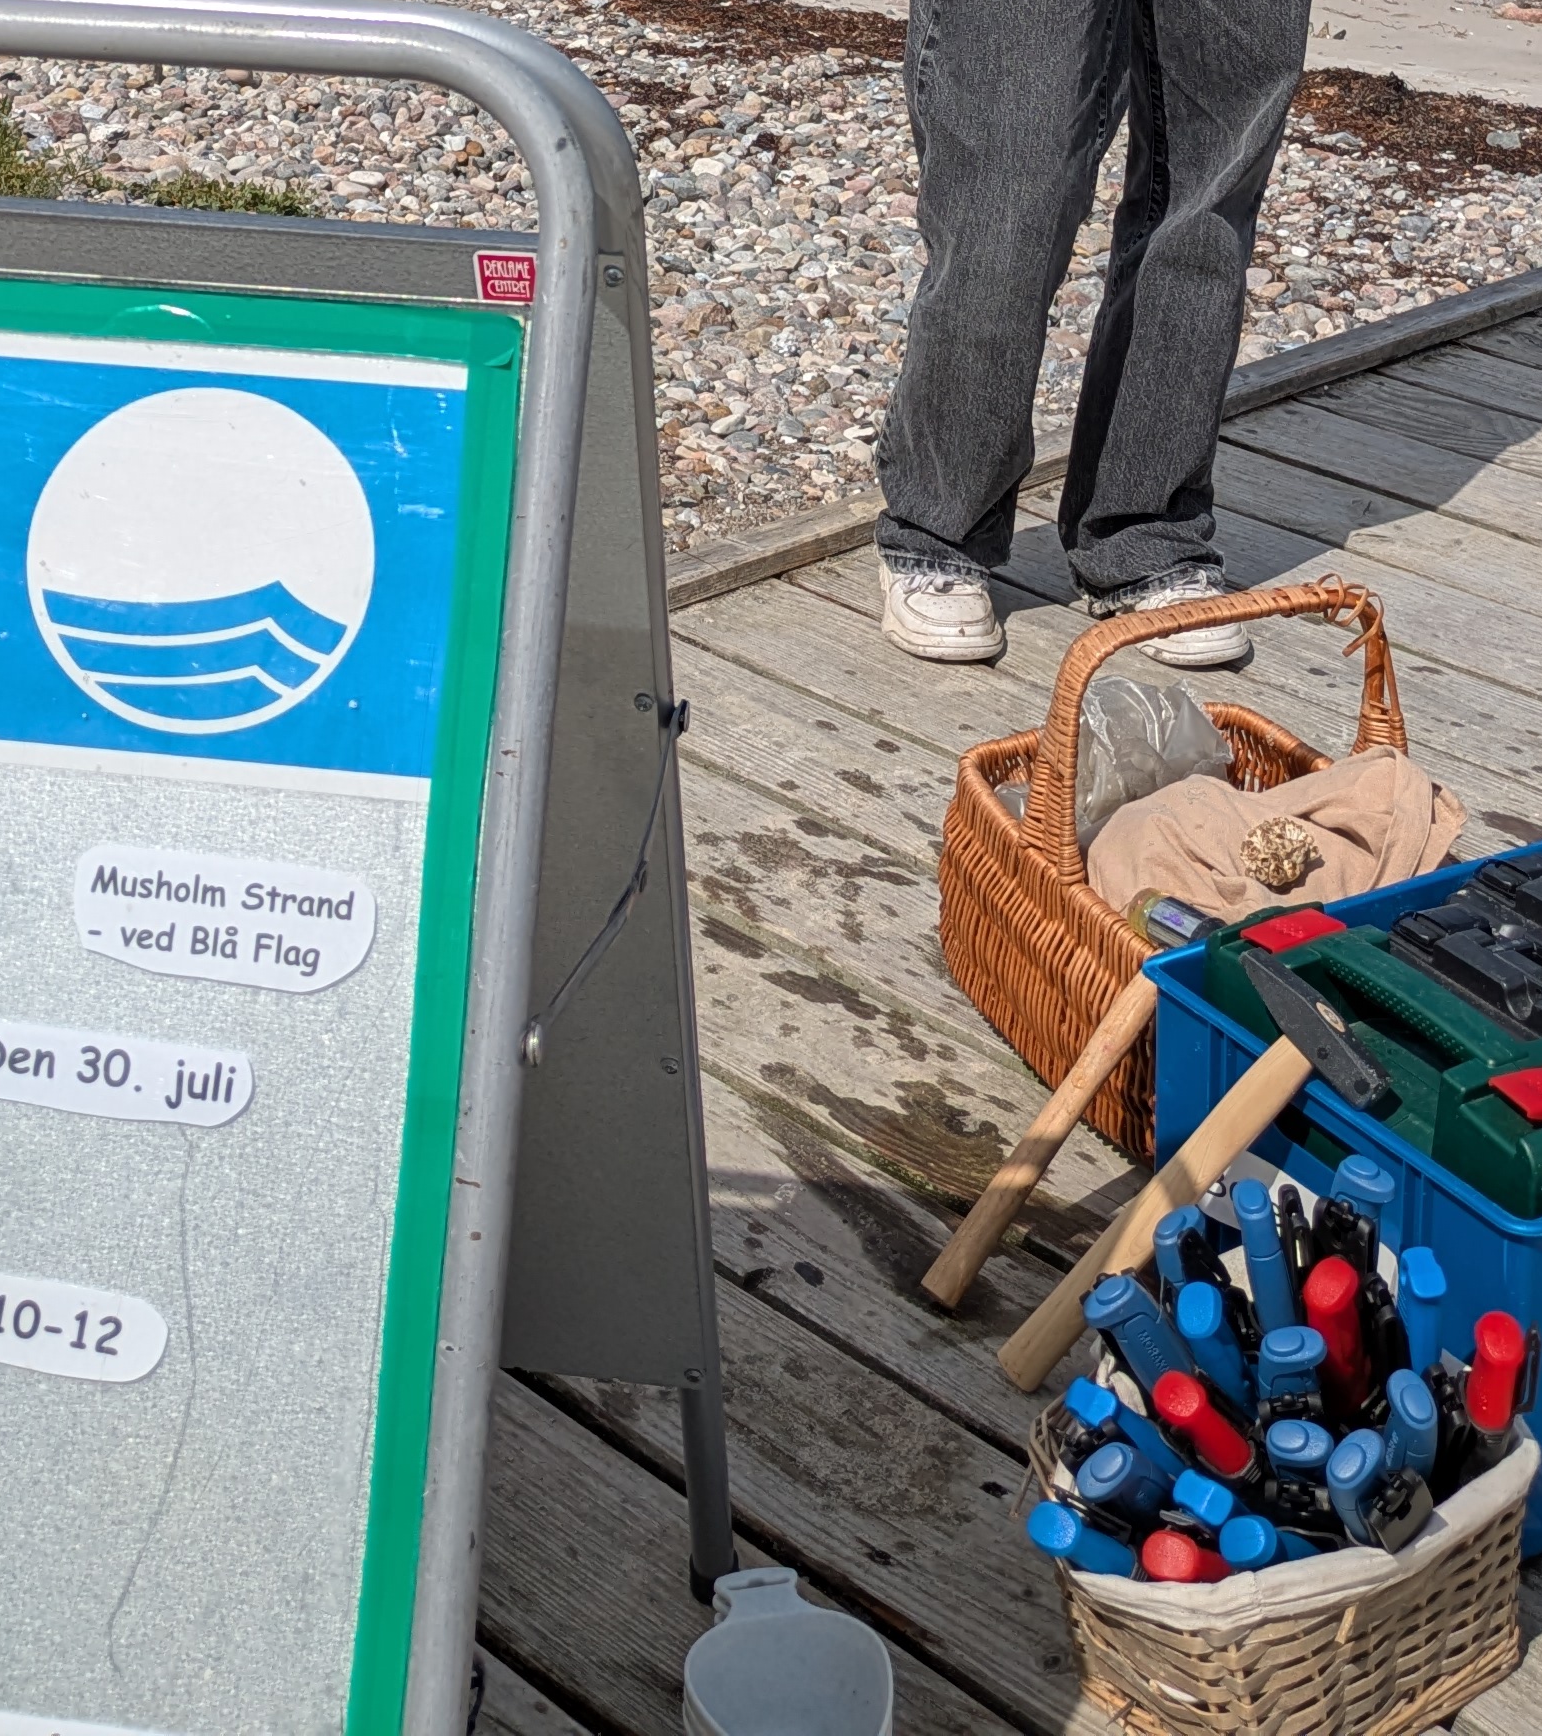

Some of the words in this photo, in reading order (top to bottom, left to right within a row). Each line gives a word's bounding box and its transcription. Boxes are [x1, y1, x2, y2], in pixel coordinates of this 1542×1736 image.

[483, 259, 531, 279] REKLAME
[487, 279, 530, 298] CENTRET
[90, 864, 226, 908] Musholm
[240, 882, 355, 921] Strand
[120, 922, 176, 953] ved
[190, 925, 239, 960] Blå
[253, 932, 321, 978] Flag
[76, 1045, 142, 1093] 30.
[164, 1059, 237, 1110] juli
